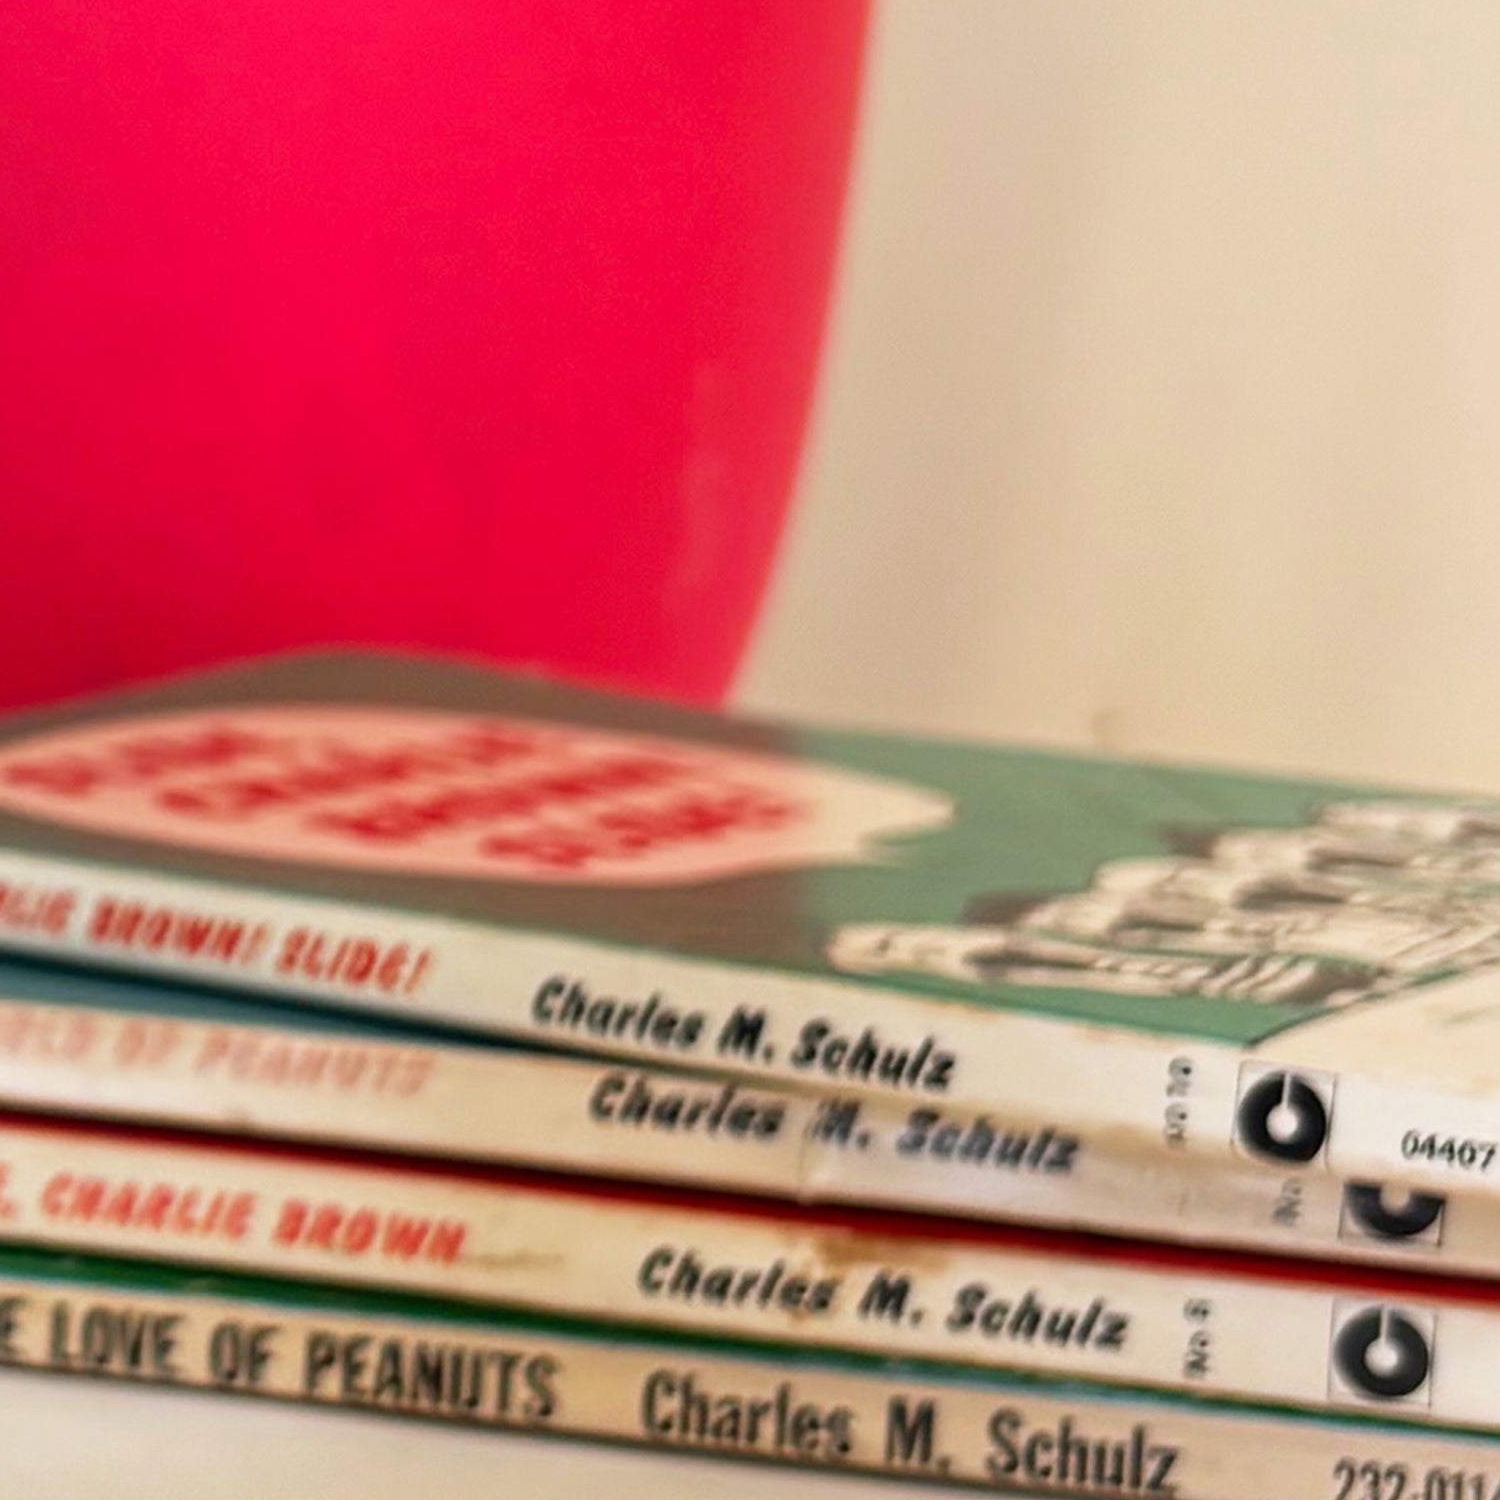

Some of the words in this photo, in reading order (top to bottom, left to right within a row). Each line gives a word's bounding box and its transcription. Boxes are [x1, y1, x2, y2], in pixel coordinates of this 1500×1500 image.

[531, 973, 706, 1050] Charles
[716, 1003, 775, 1065] M.
[791, 1017, 957, 1093] Schulz
[589, 1070, 787, 1142] Charles
[805, 1098, 873, 1153] M.
[898, 1106, 1081, 1175] Schulz
[40, 1172, 255, 1244] CHARLIE
[272, 1198, 468, 1268] BROWN
[638, 1243, 844, 1315] Charles
[857, 1269, 926, 1328] M.
[945, 1280, 1132, 1354] Schulz
[49, 1298, 184, 1373] LOVE
[208, 1317, 283, 1386] OF
[304, 1331, 562, 1423] PEANUTS
[640, 1367, 857, 1457] Charles
[884, 1395, 952, 1477] M.
[984, 1406, 1184, 1494] Schulz
